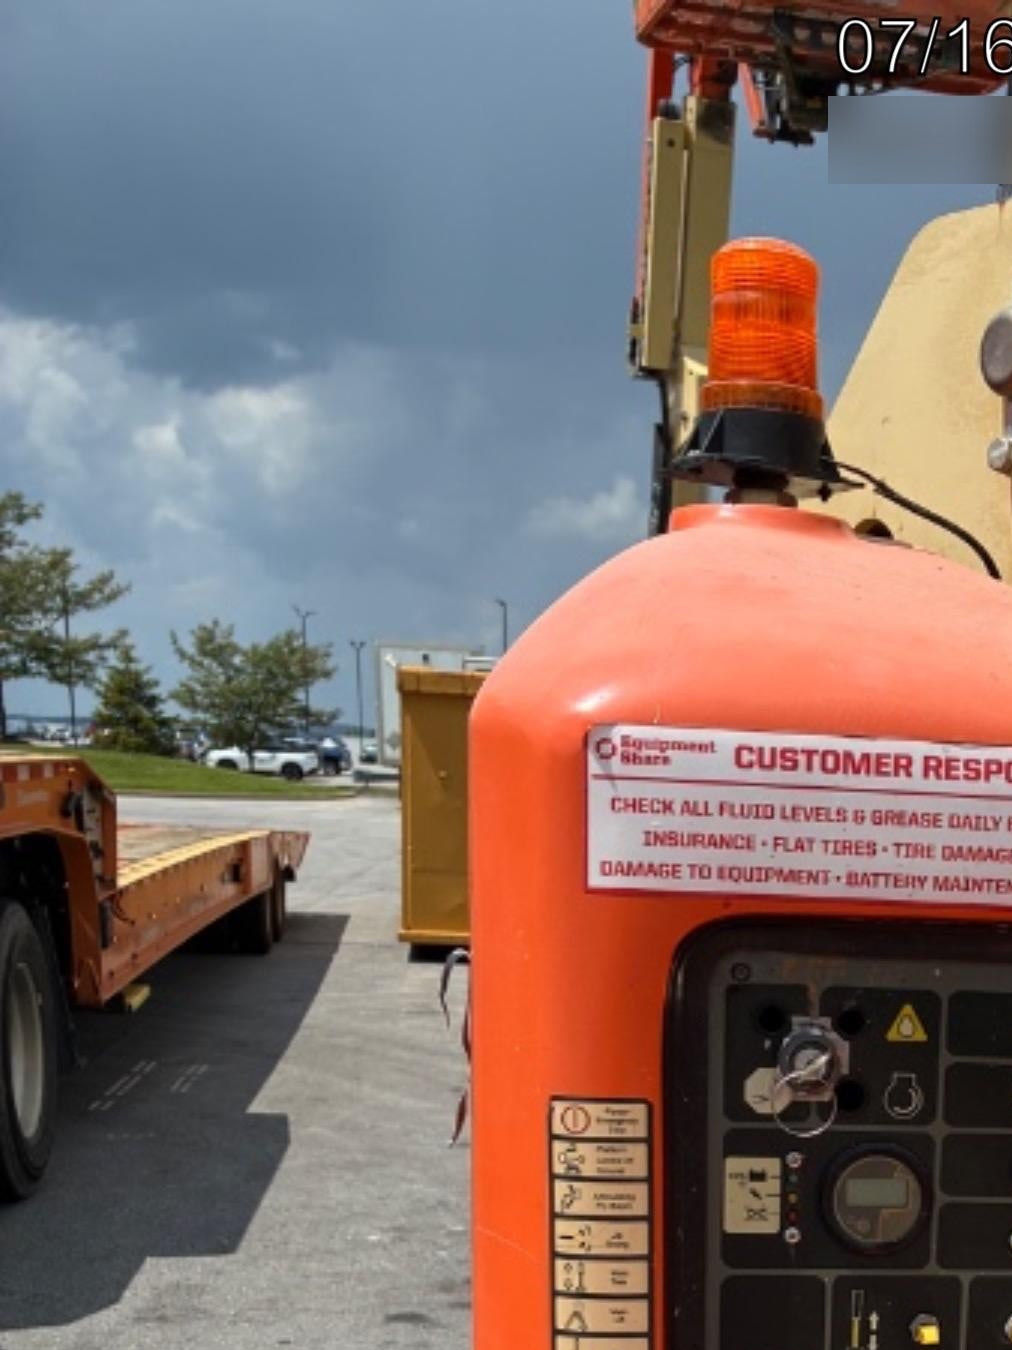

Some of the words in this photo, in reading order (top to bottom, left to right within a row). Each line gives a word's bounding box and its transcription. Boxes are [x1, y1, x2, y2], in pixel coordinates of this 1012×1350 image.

[620, 735, 717, 754] Equipment
[734, 745, 912, 778] CUSTOMER
[611, 797, 675, 816] CHECK
[681, 801, 713, 817] ALL
[719, 802, 775, 820] FLUID
[781, 804, 848, 823] LEVELS
[872, 810, 943, 829] GREASE
[948, 814, 1002, 832] DAILY
[643, 830, 756, 851] INSURANCE
[773, 837, 815, 853] FLAT
[821, 840, 877, 856] TIRES
[892, 843, 936, 859] TIRE
[600, 861, 682, 879] DAMAGE
[687, 864, 712, 880] TO
[717, 865, 831, 884] EQUIPMENT
[845, 871, 928, 890] BATTERY
